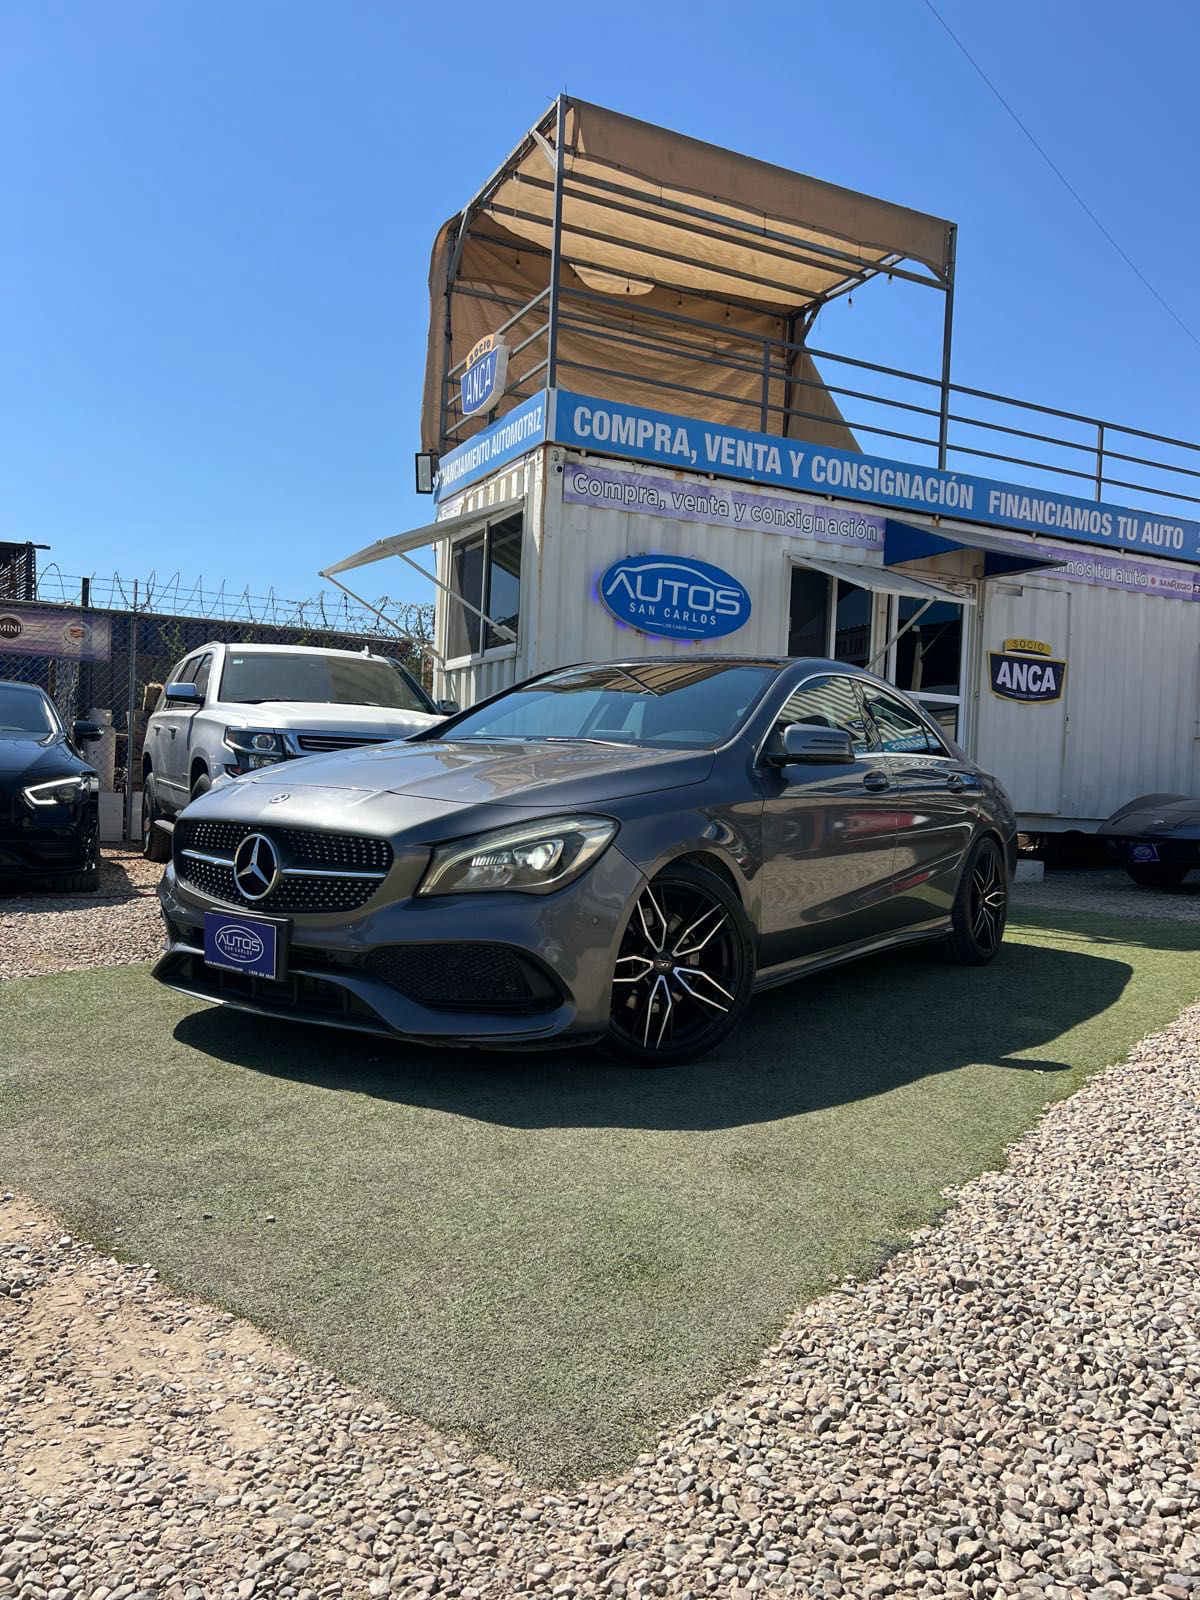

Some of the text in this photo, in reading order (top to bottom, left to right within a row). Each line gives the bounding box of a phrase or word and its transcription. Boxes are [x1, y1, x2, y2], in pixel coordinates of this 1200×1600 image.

[466, 358, 491, 404] ANCA
[491, 406, 542, 458] AUTOMOTRIZ
[573, 406, 697, 464] COMPRA,
[705, 433, 782, 475] VENTA
[789, 451, 804, 478] Y
[812, 455, 973, 510] CONSIGNACIÓN
[989, 490, 1113, 536] FINANCIAMOS
[1117, 516, 1138, 541] TU
[1141, 521, 1184, 550] AUTO
[573, 473, 878, 542] Compra, venta y consignación
[606, 572, 740, 615] AUTOS
[1116, 568, 1148, 586] auto
[629, 603, 717, 625] SAN CARLOS
[1012, 640, 1044, 651] SOCIO
[996, 661, 1056, 692] ANCA
[218, 934, 260, 951] AUTOS
